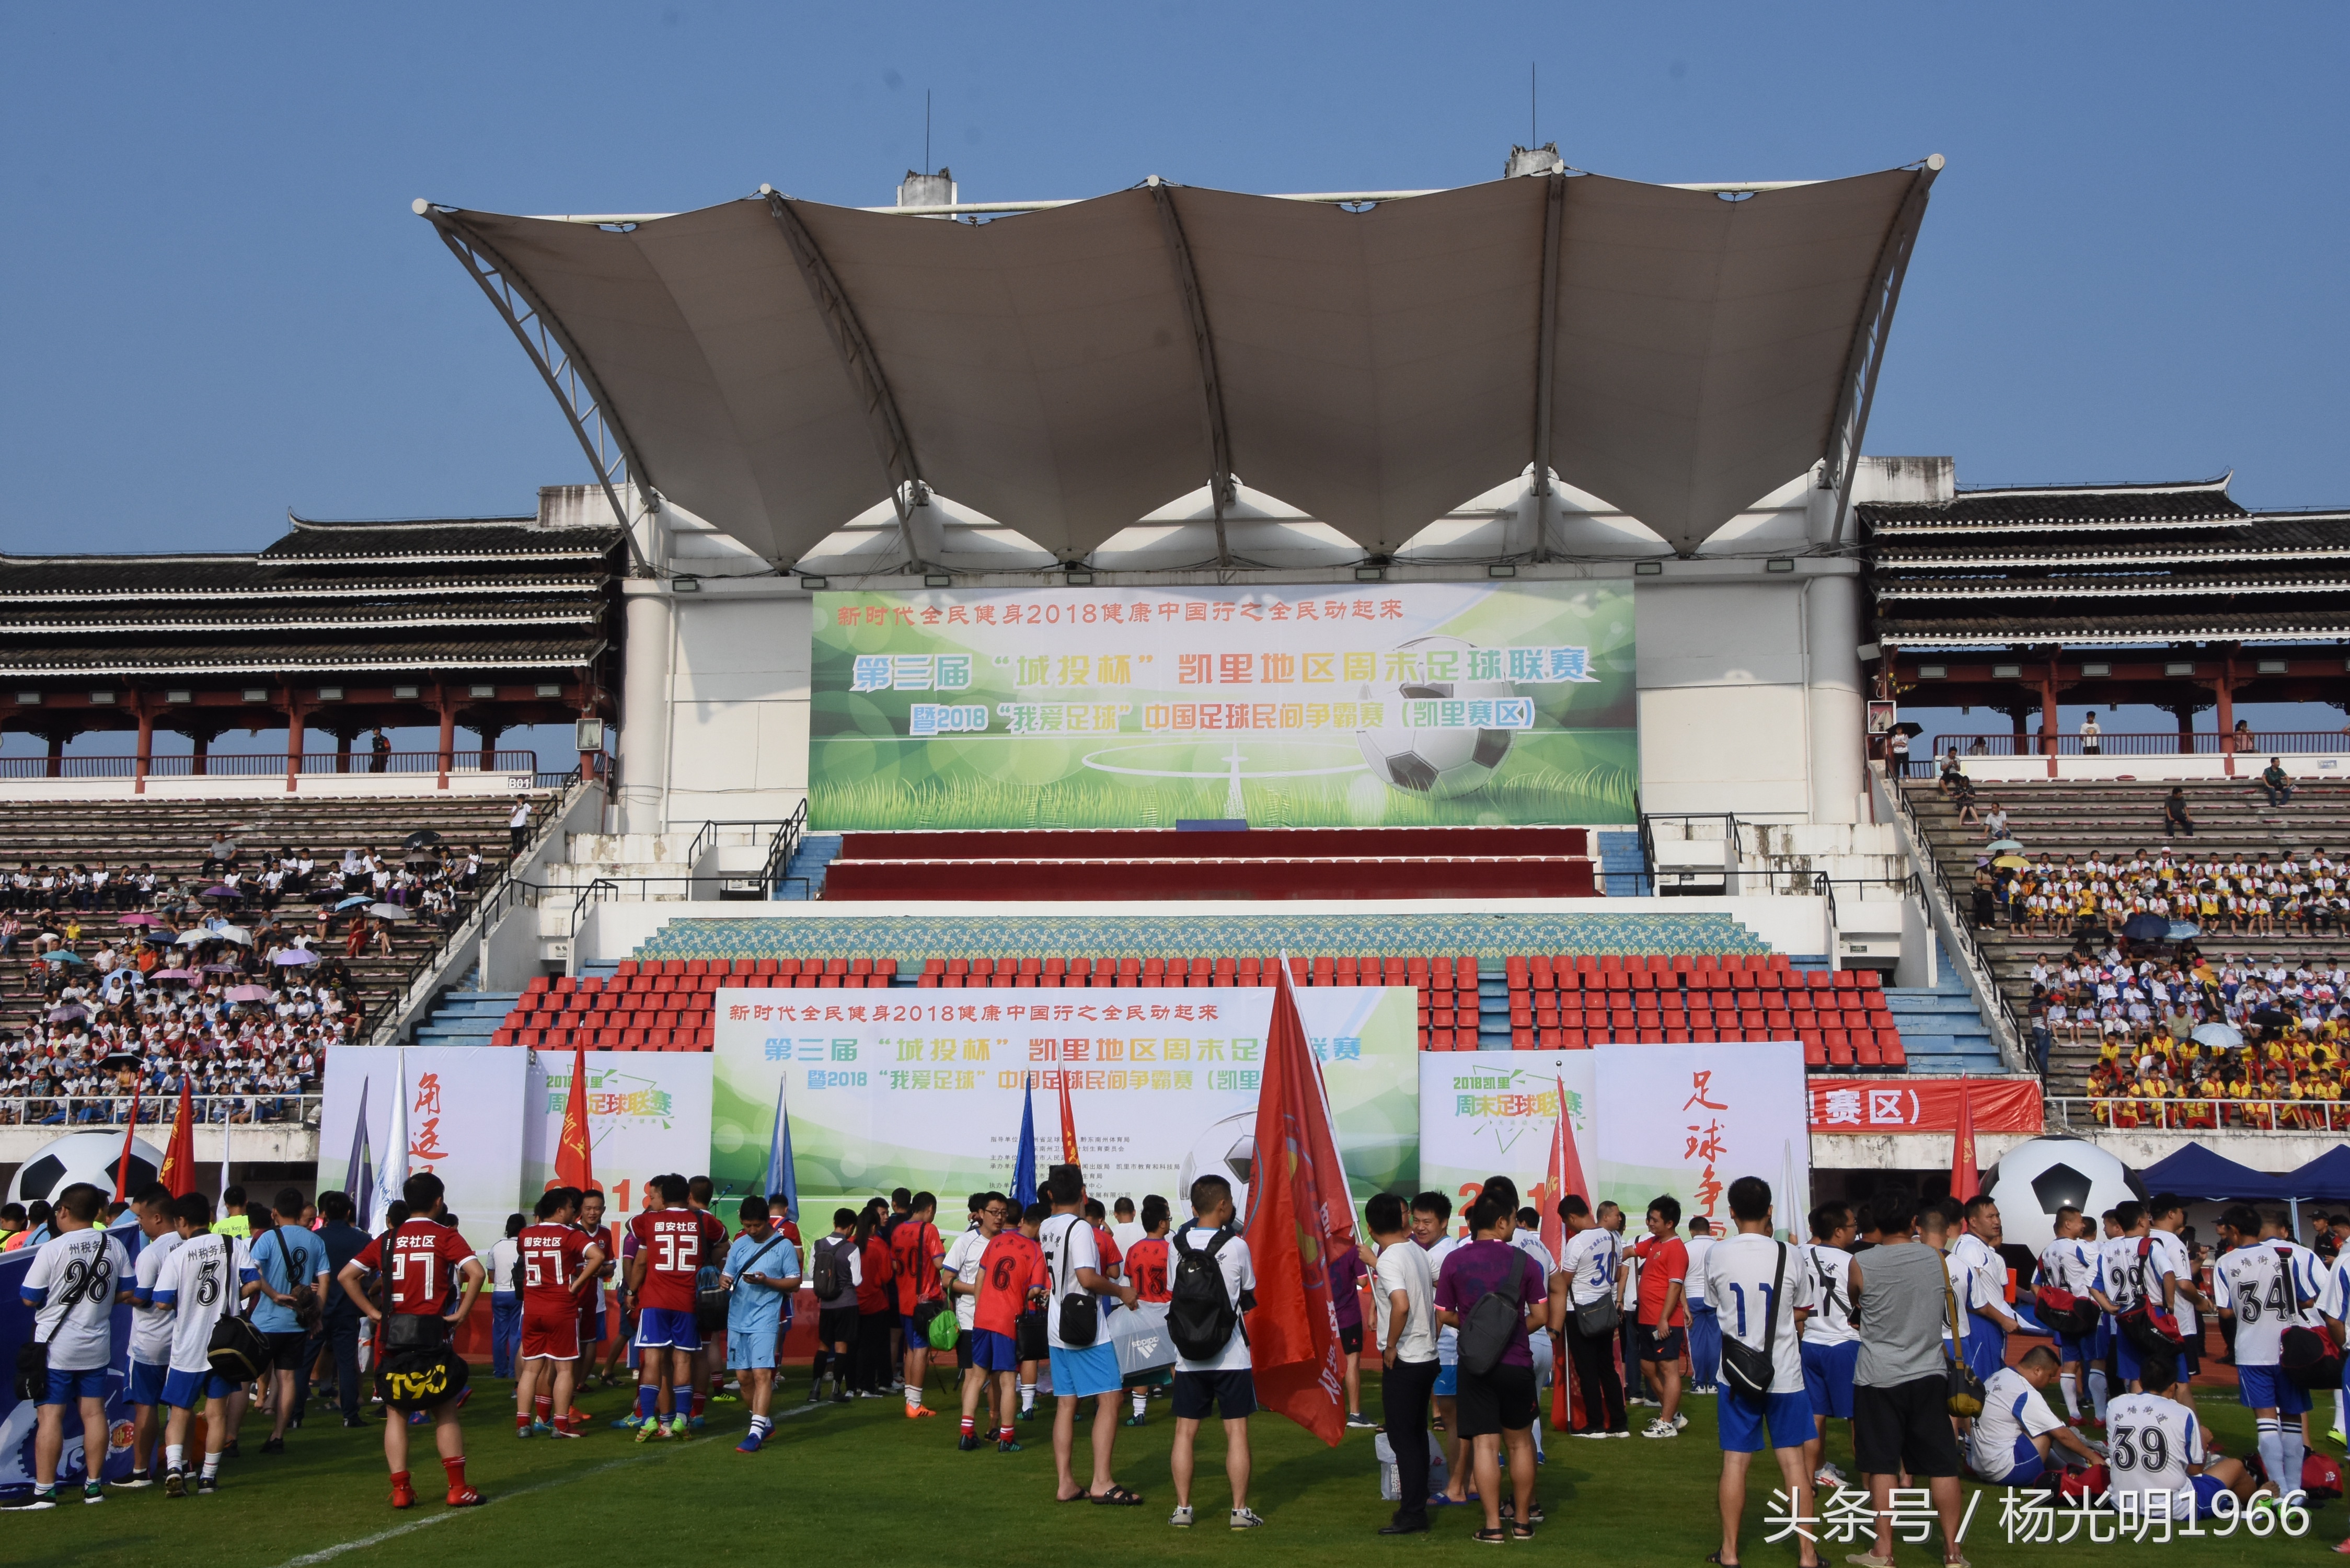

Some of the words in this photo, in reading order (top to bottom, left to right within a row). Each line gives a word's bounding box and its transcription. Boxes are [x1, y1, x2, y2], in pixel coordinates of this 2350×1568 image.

[837, 598, 1403, 626] 新时代全民健身2018健康中国行之全民动起来
[509, 779, 529, 788] B01
[730, 1004, 1219, 1022] 新时代全民健身2018健康中国行之全民动起来
[1453, 1076, 1510, 1090] 2018凯里
[546, 1089, 672, 1115] 周足球联赛
[524, 1237, 561, 1248] 国安社区
[654, 1221, 697, 1232] 国安社区
[286, 1247, 308, 1282] 8
[524, 1250, 564, 1286] 67
[655, 1235, 698, 1271] 32
[1590, 1253, 1617, 1286] 30
[59, 1256, 113, 1305] 28
[197, 1260, 221, 1307] 3
[992, 1255, 1016, 1291] 6
[1135, 1264, 1167, 1297] 13
[2110, 1262, 2148, 1304] 29
[2237, 1274, 2288, 1324] 34
[1132, 1336, 1159, 1347] adidas
[2112, 1424, 2169, 1473] 39
